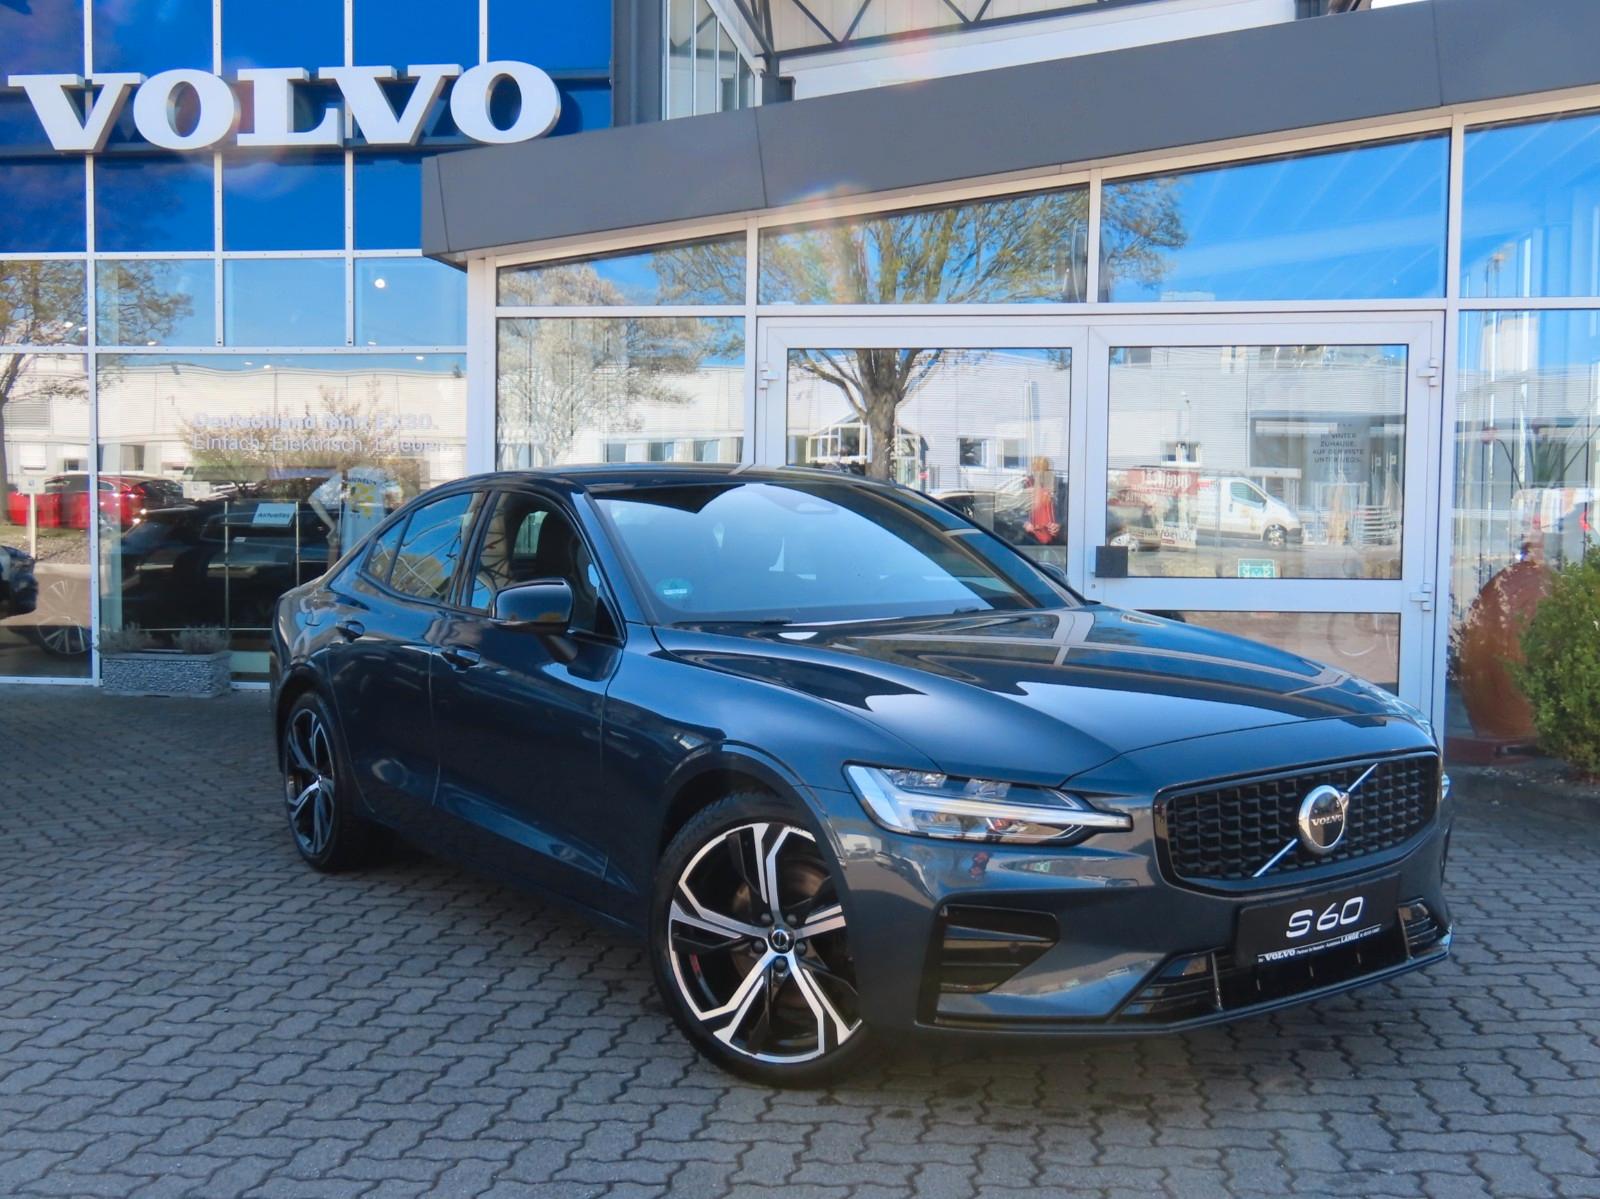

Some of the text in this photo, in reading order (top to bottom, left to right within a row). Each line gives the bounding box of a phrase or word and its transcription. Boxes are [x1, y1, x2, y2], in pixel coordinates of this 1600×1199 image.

[8, 59, 562, 152] VOLVO
[192, 412, 316, 429] Deutschland
[272, 434, 368, 452] Elektrisch.
[1311, 814, 1343, 826] VOLVO
[1286, 896, 1364, 939] S 60
[1264, 949, 1296, 962] VOLVO
[1340, 932, 1360, 944] LANGE
